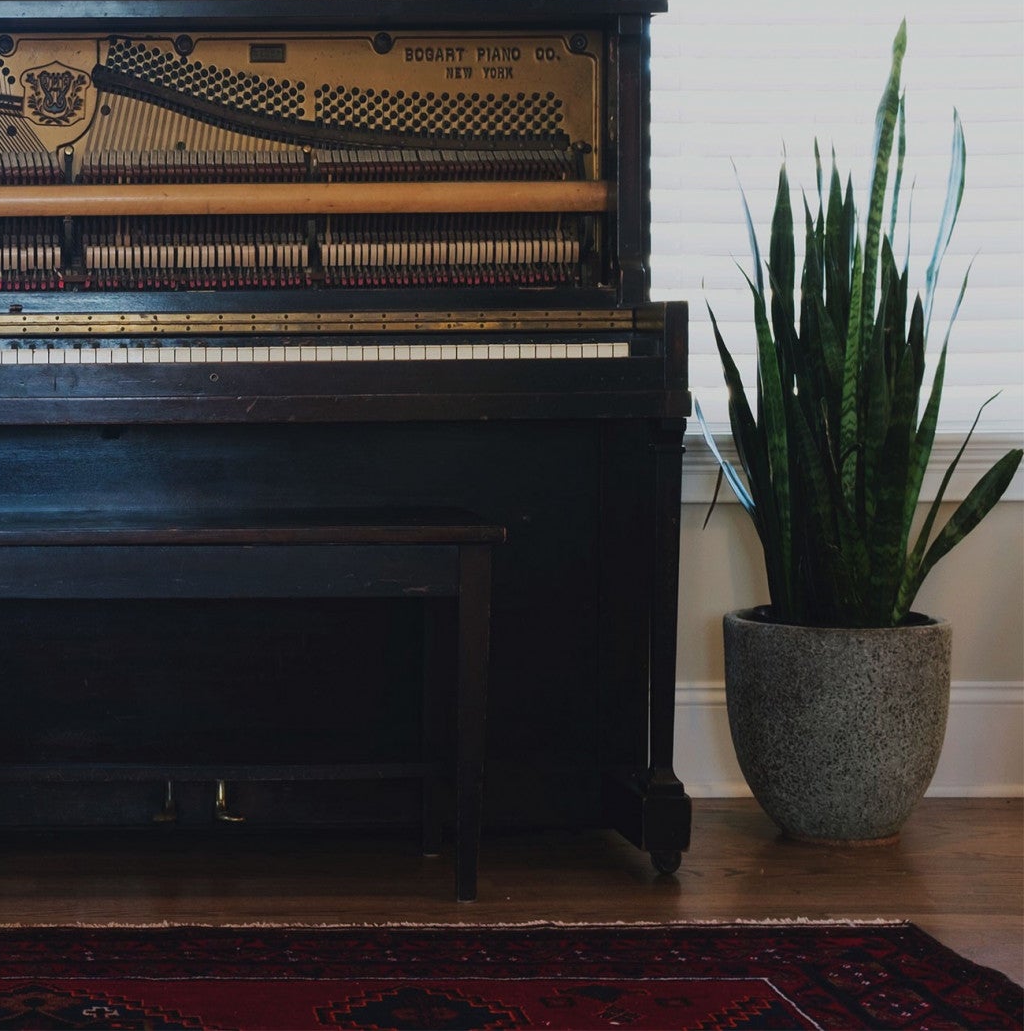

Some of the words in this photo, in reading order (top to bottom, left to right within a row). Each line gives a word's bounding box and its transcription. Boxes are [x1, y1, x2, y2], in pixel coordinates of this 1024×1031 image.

[405, 47, 464, 62] BOGART
[477, 47, 521, 62] PIANO
[446, 66, 472, 79] NEW
[483, 66, 513, 79] YORK
